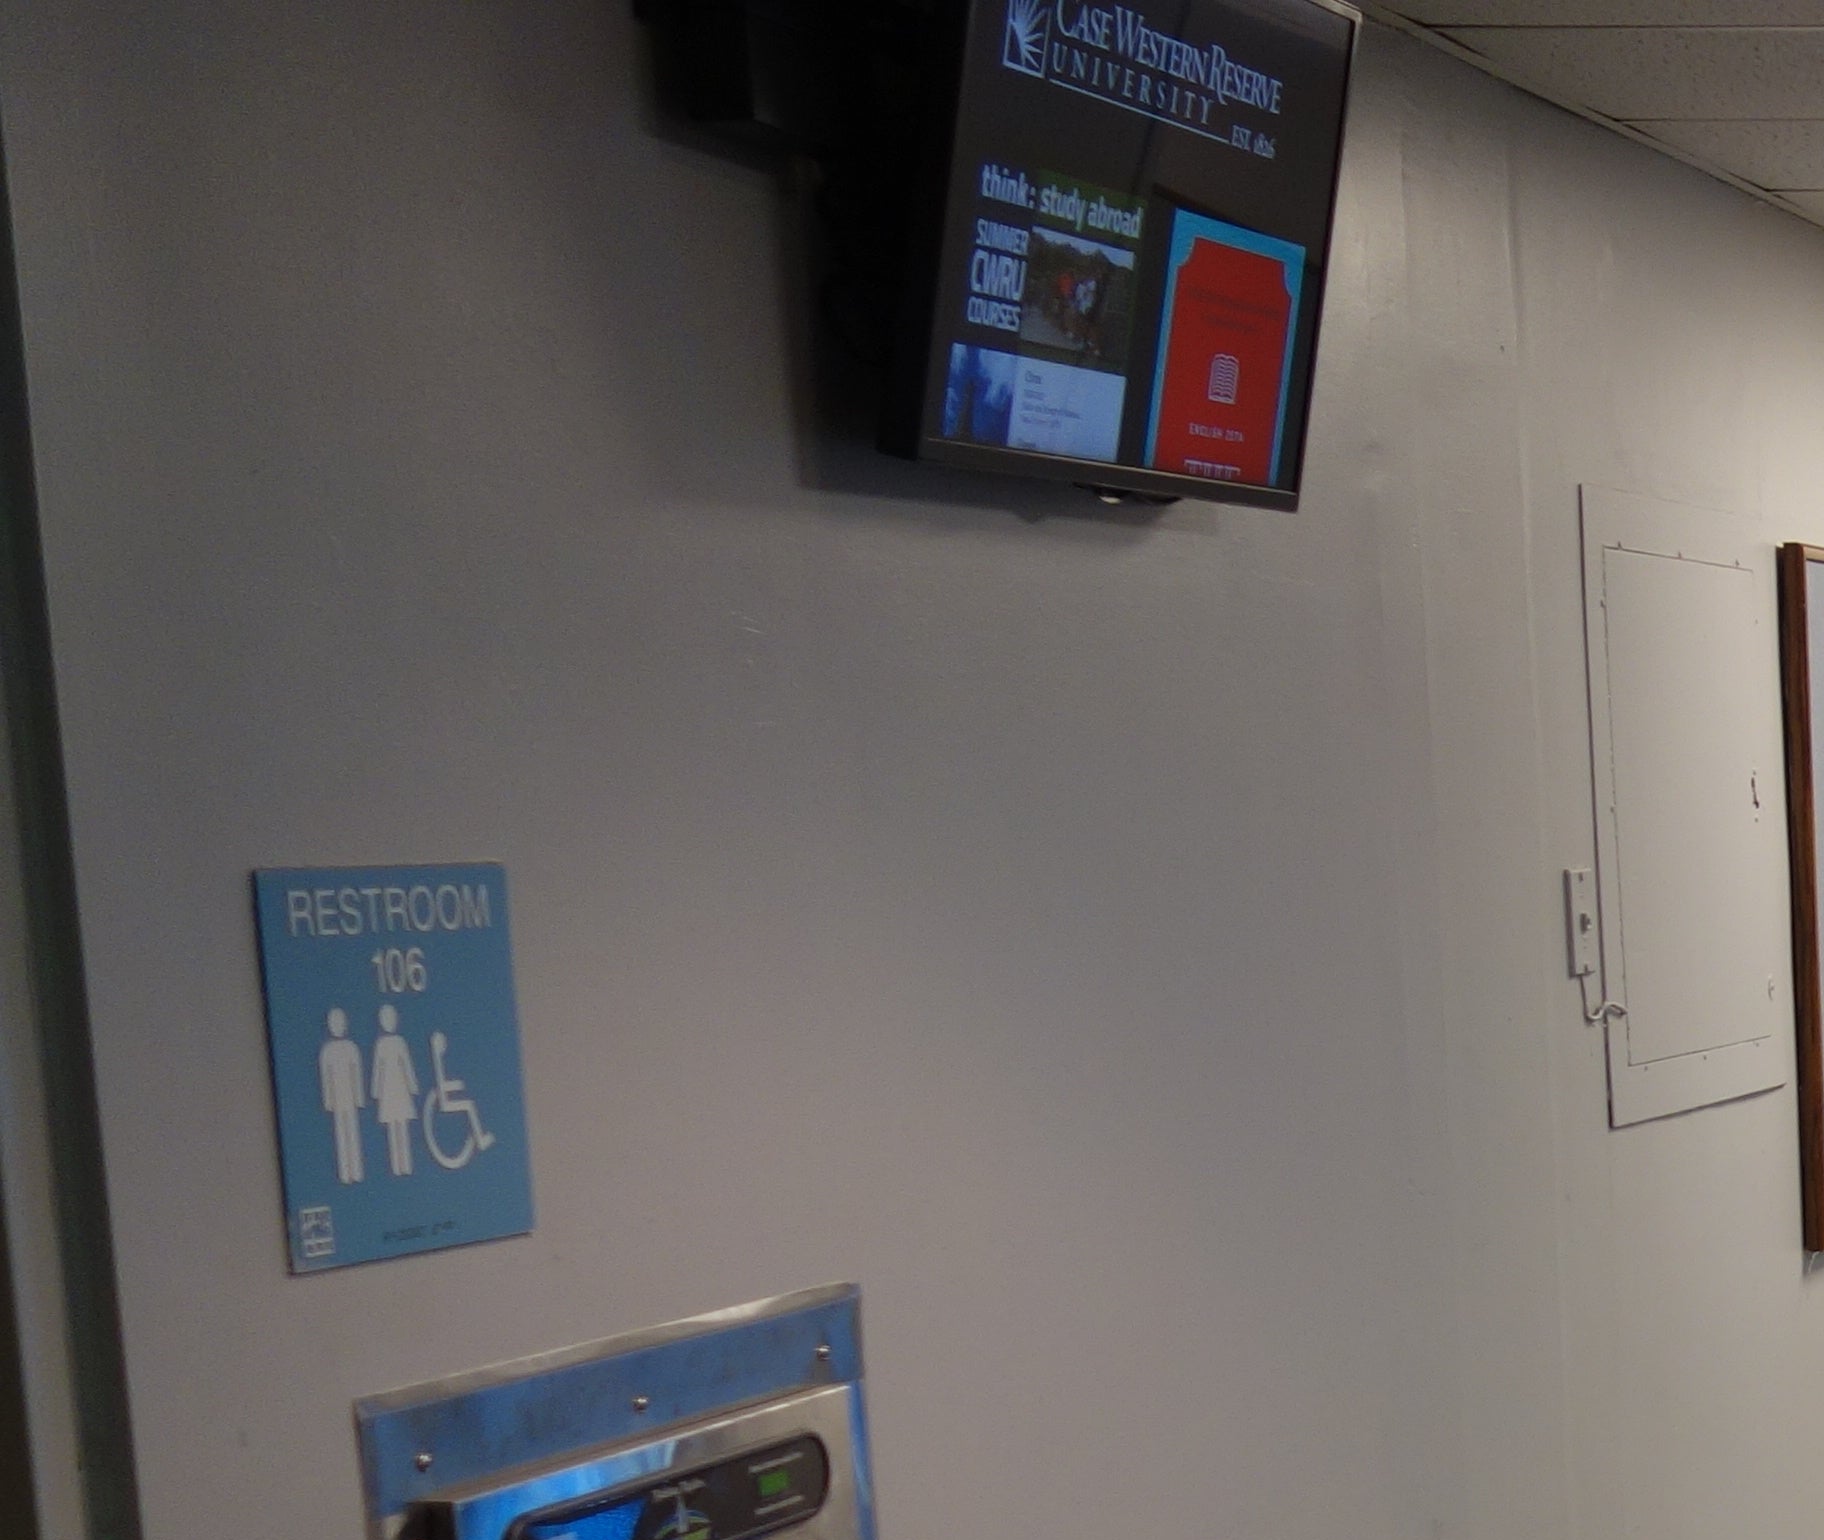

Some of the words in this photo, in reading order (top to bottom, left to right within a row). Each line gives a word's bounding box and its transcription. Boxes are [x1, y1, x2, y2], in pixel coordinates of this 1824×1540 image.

[1052, 41, 1215, 125] UNIVERSITY
[1114, 5, 1210, 87] WESTERN
[1210, 44, 1284, 116] RESERVE
[981, 163, 1037, 209] think:
[1039, 184, 1087, 232] study
[1087, 195, 1144, 239] abroad
[975, 217, 1029, 256] SUMMER
[970, 249, 1028, 302] CWRU
[967, 296, 1022, 333] COURSES
[286, 884, 493, 938] RESTROOM
[371, 946, 428, 994] 106
